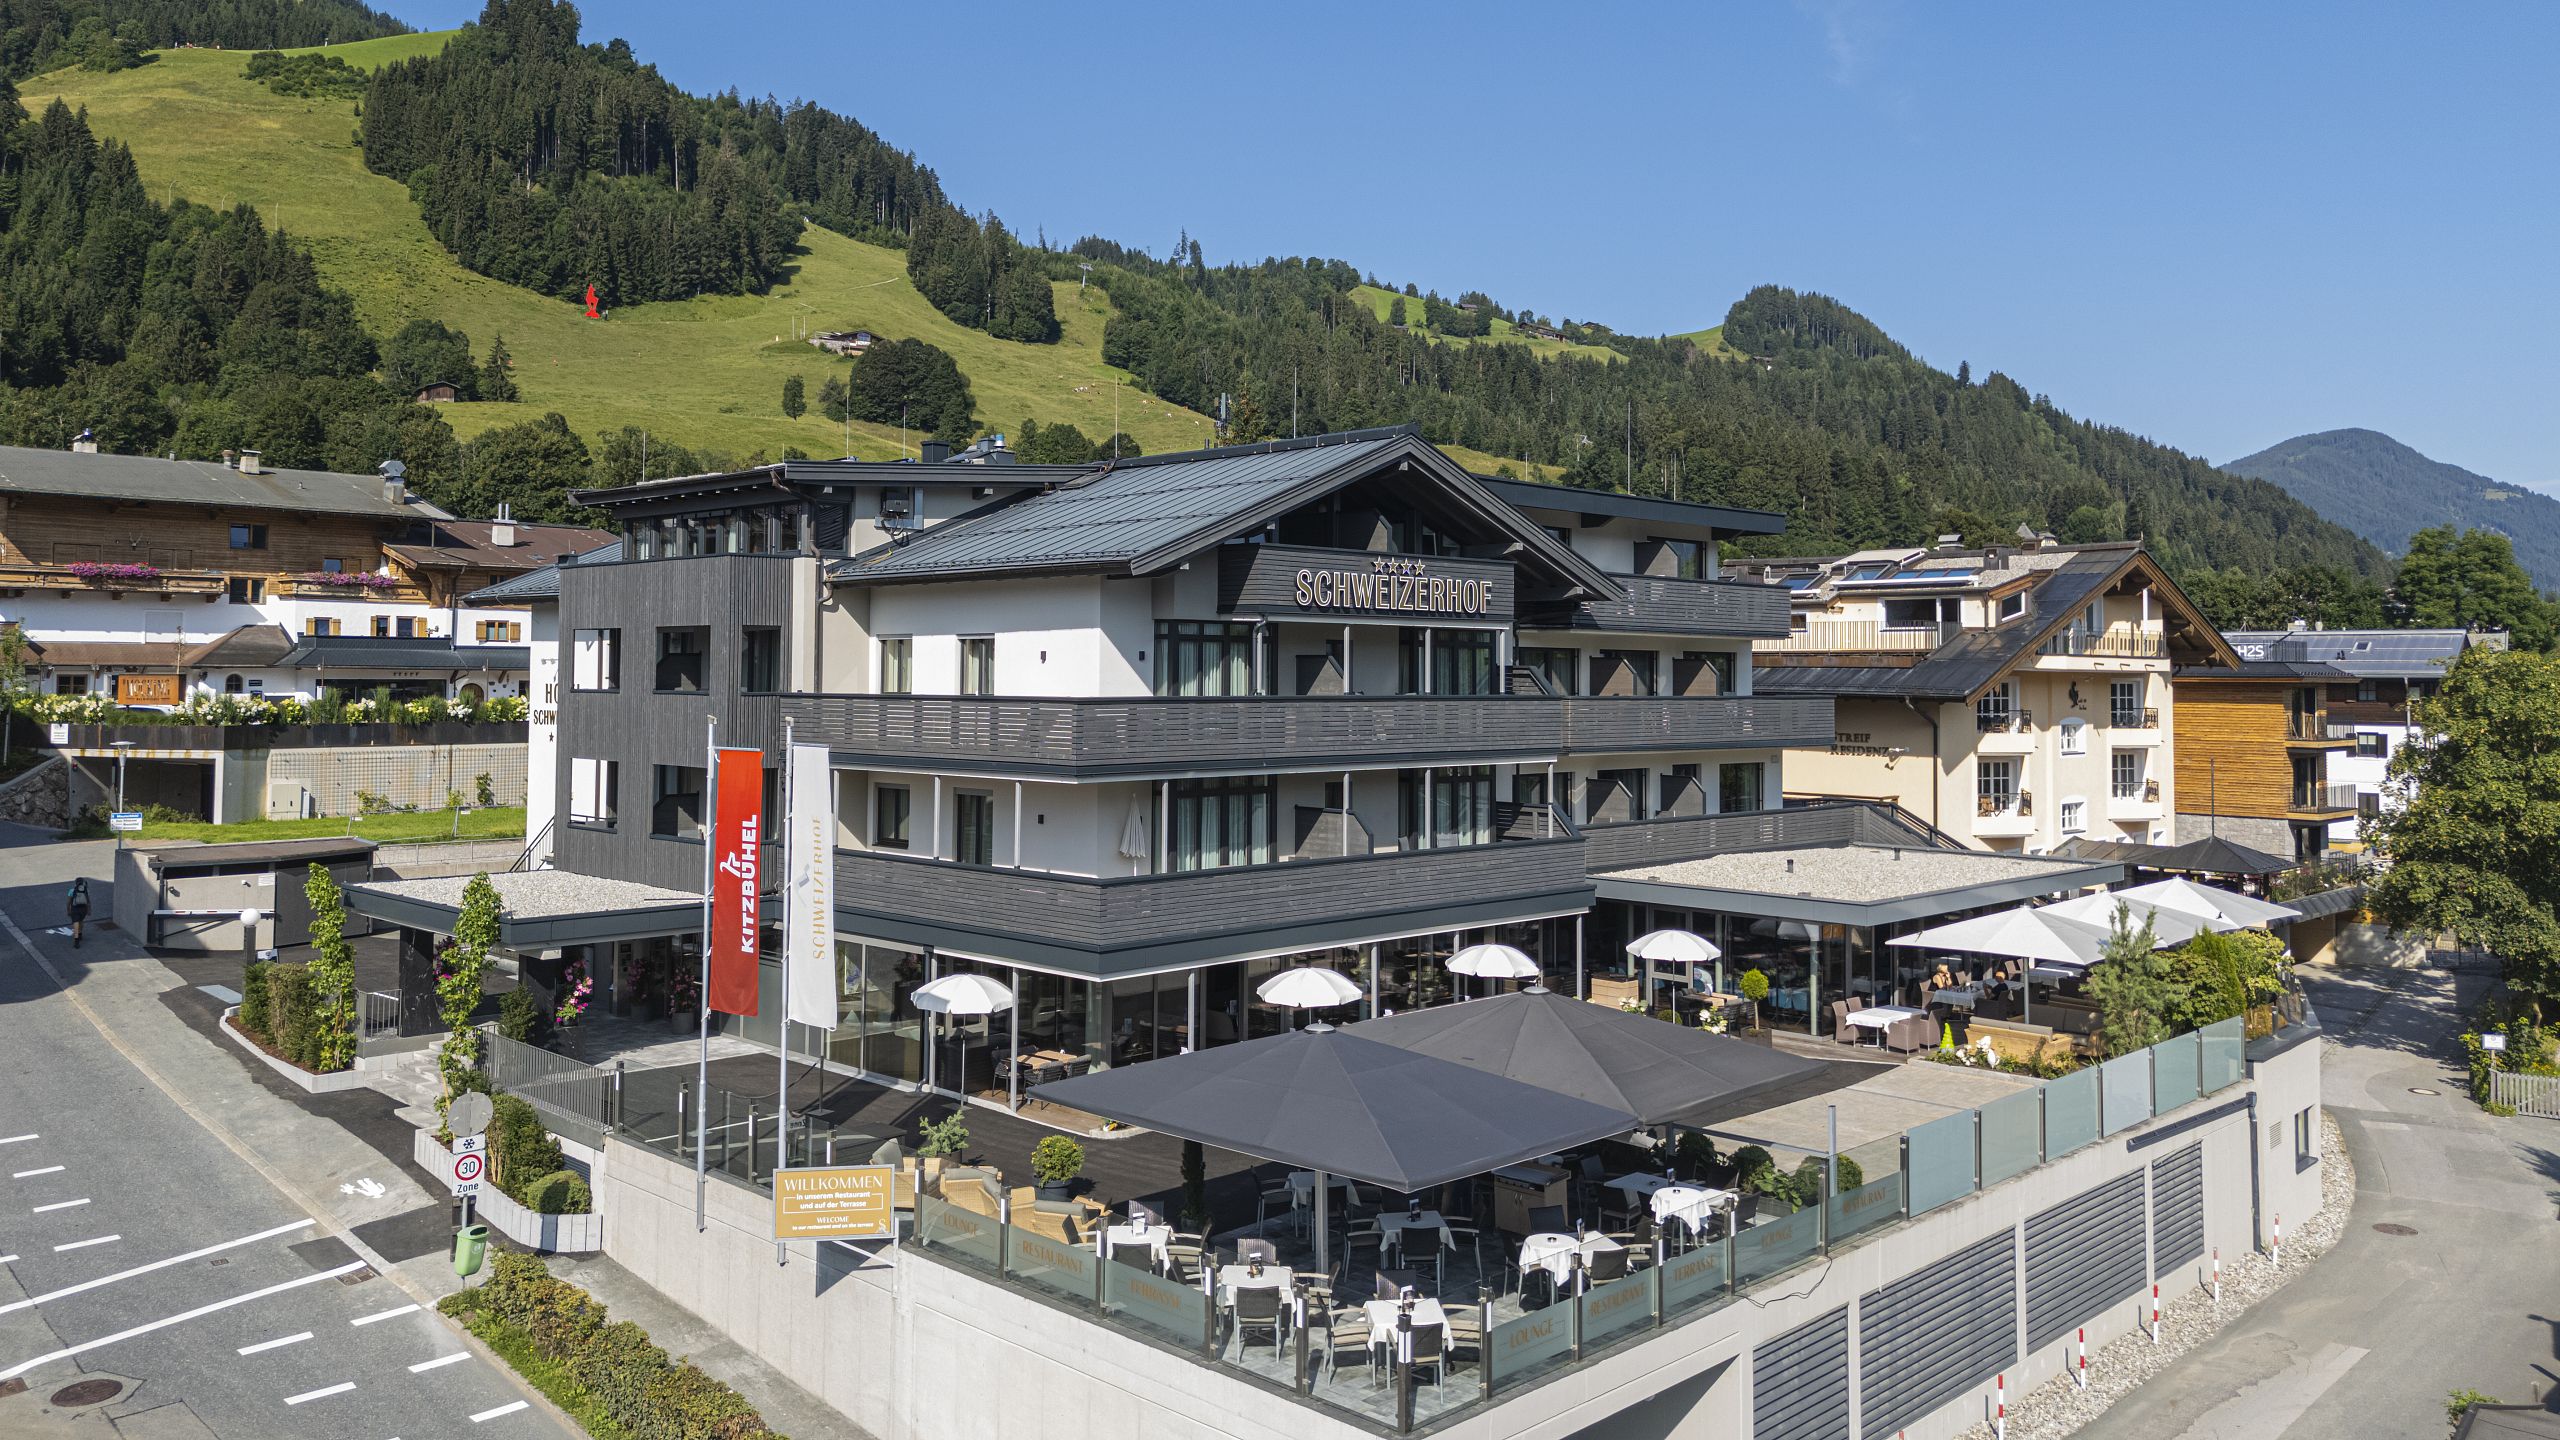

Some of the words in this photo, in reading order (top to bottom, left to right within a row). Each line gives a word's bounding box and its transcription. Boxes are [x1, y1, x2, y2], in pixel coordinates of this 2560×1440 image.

[1296, 569, 1493, 614] SCHWEIZERHOF
[2237, 645, 2264, 657] H2S
[741, 814, 757, 954] KITZBÜHEL
[812, 816, 826, 960] SCHWEIZERHOF
[461, 1161, 476, 1175] 30
[457, 1183, 479, 1194] Zone
[784, 1176, 883, 1191] WILLKOMMEN
[804, 1192, 834, 1200] unserem
[839, 1200, 867, 1208] Terrasse
[816, 1216, 850, 1224] WELCOME
